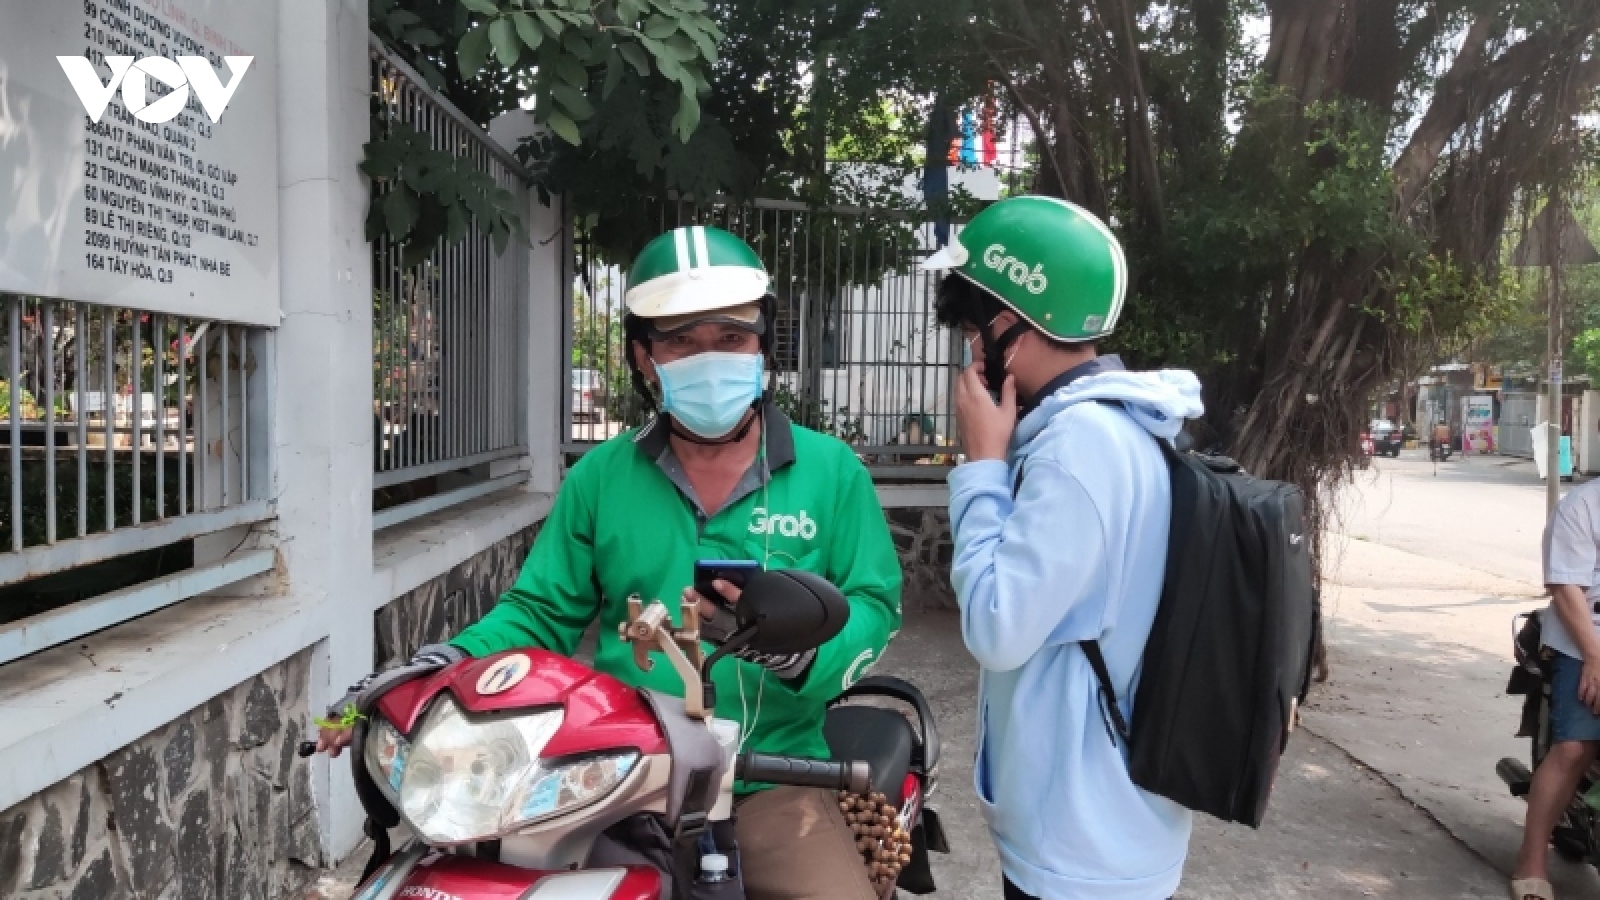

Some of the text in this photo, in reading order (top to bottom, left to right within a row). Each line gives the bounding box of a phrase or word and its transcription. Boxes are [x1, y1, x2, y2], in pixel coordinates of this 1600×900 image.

[84, 21, 104, 45] 210
[84, 137, 103, 159] 131
[105, 144, 137, 171] CÁCH
[125, 131, 154, 157] PHAN
[84, 160, 98, 180] 22
[84, 183, 98, 203] 60
[84, 206, 98, 225] 89
[99, 209, 114, 230] LÊ
[84, 229, 110, 251] 2099
[84, 251, 104, 271] 164
[107, 254, 128, 275] TÂY
[983, 243, 1048, 295] Grab
[747, 506, 817, 541] Grab
